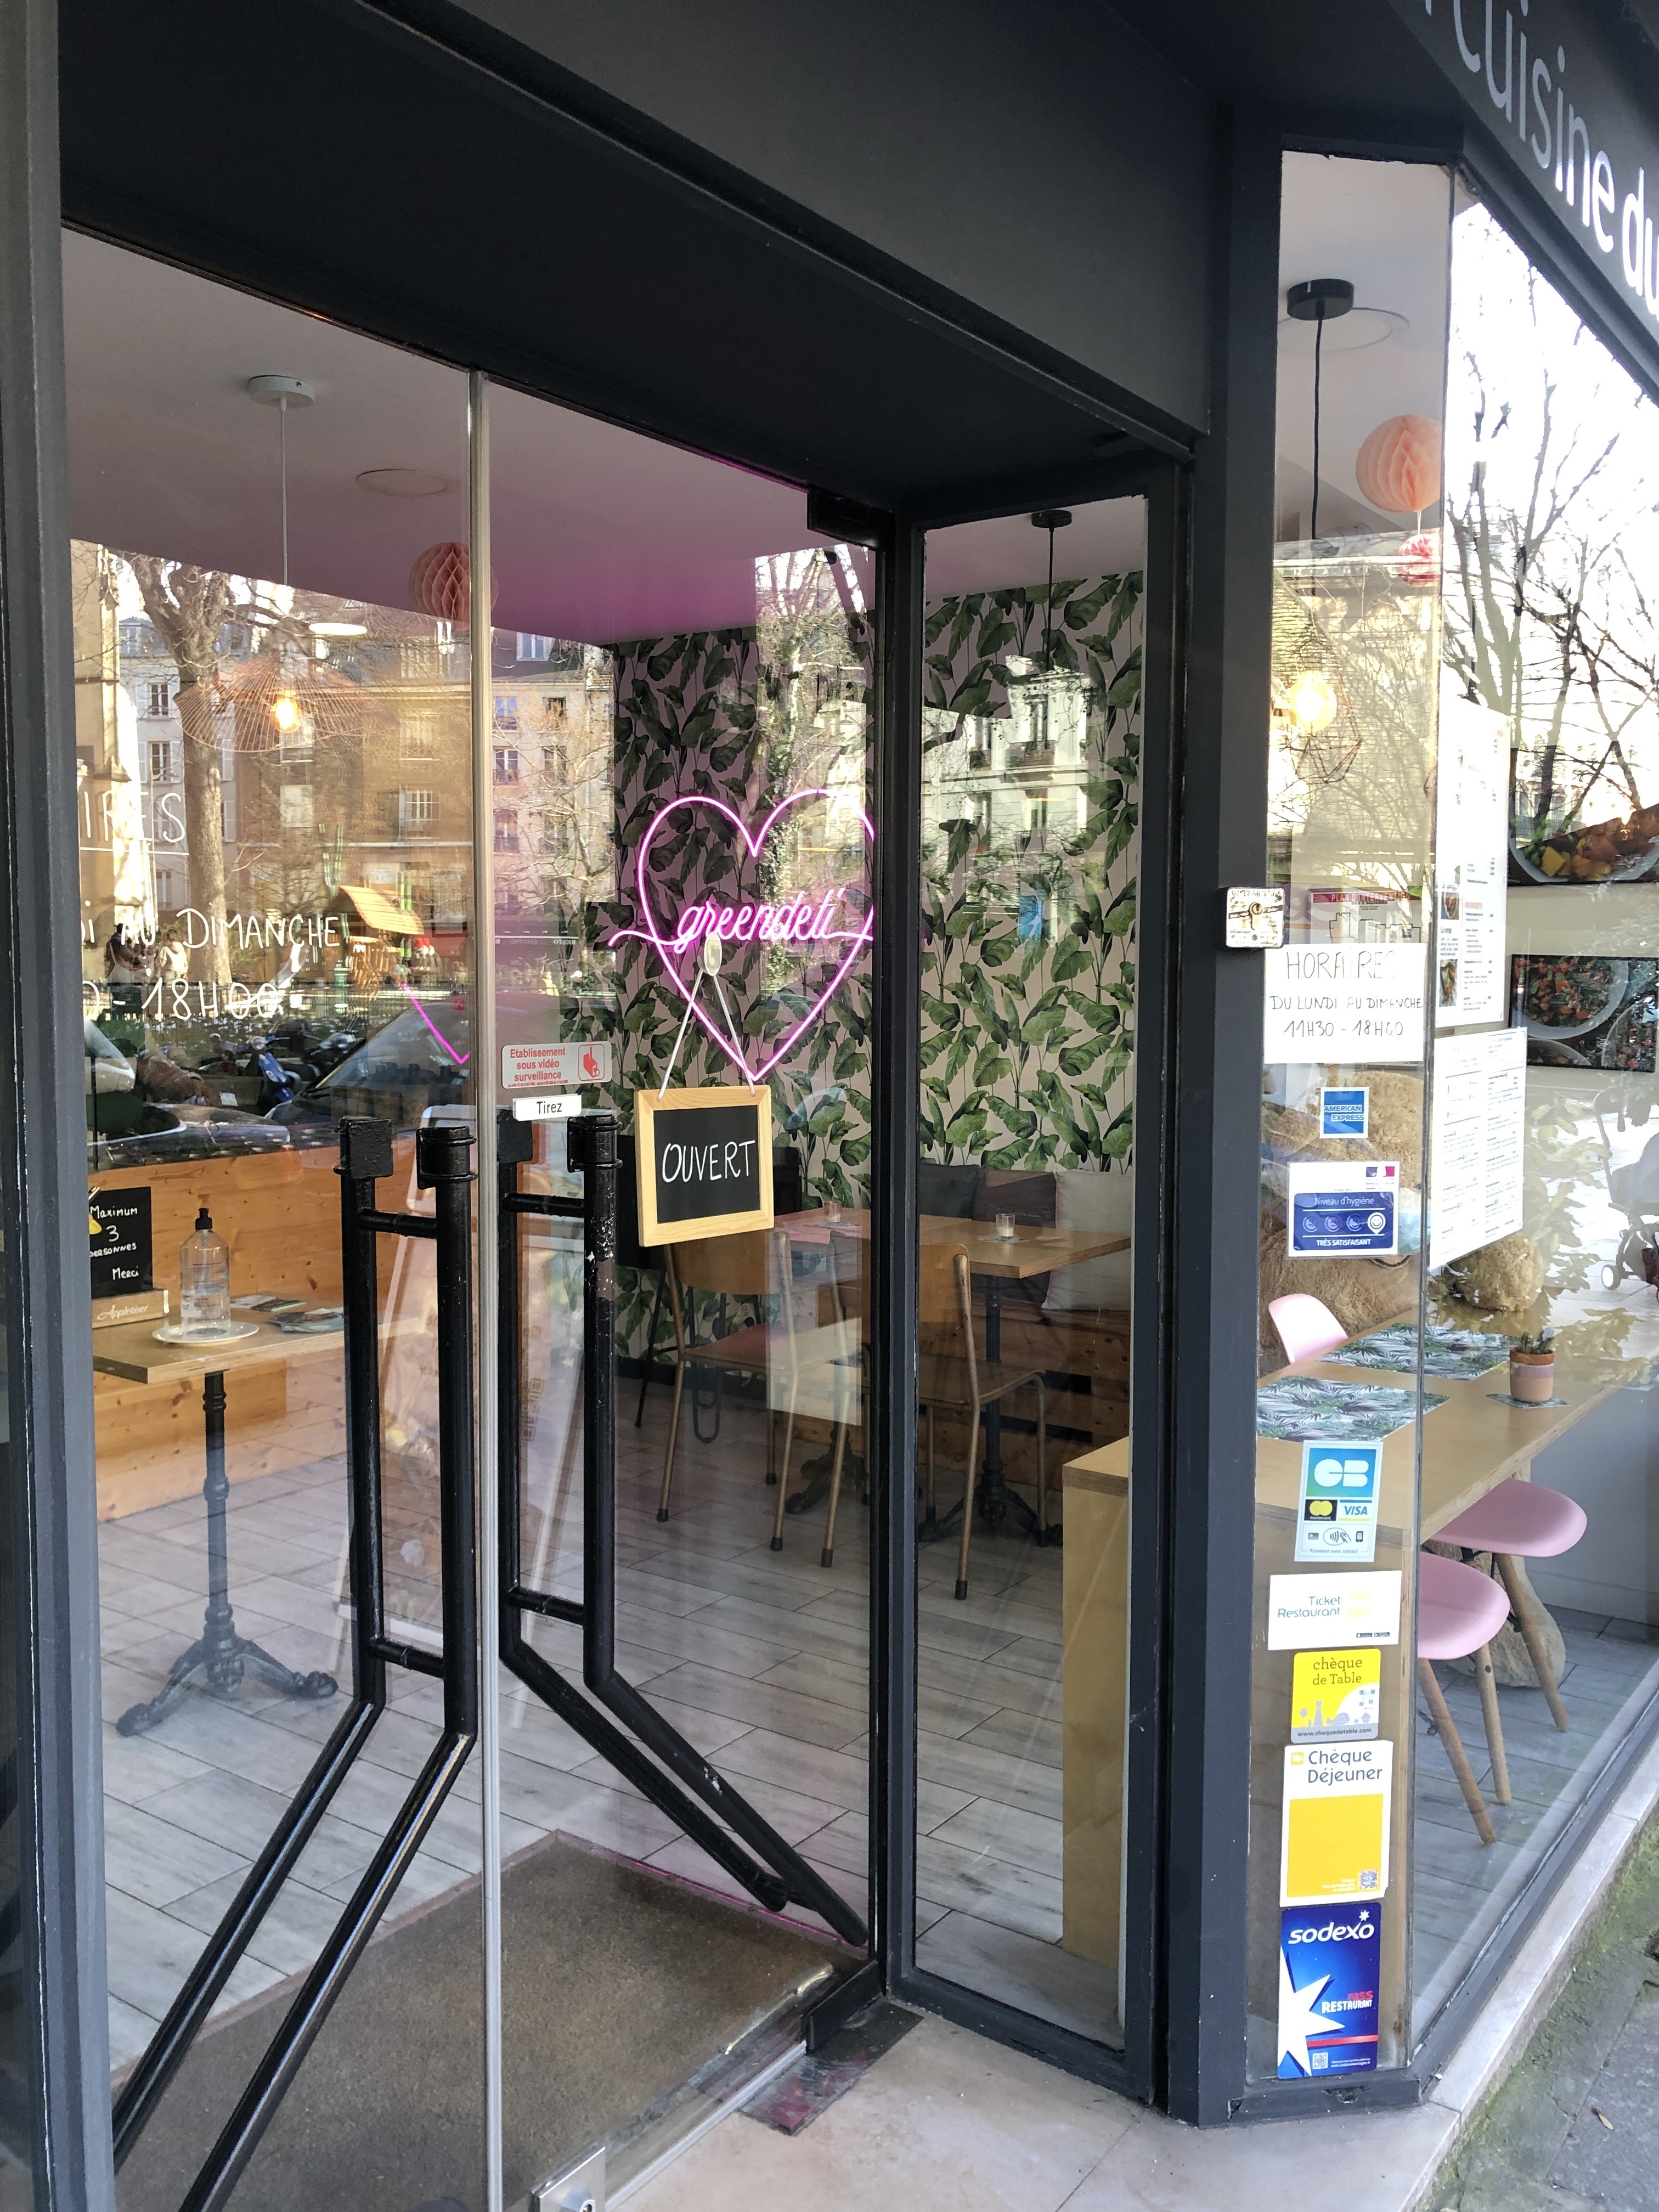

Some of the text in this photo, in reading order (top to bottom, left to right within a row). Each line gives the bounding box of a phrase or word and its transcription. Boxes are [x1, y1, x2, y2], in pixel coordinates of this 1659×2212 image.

[1331, 893, 1350, 902] PLAN
[1269, 995, 1291, 1010] DU
[1297, 995, 1338, 1010] LUNDI
[1347, 996, 1362, 1009] AU
[1284, 1019, 1334, 1037] 11H30
[1352, 1019, 1404, 1037] 18H00
[510, 1047, 566, 1059] Etablissement
[516, 1059, 560, 1070] sous vidéo
[514, 1070, 562, 1082] surveillance
[535, 1101, 562, 1115] Tirez
[662, 1139, 756, 1183] OUVERT
[1314, 1197, 1339, 1206] Niveau
[106, 1224, 120, 1243] 3
[1316, 1238, 1372, 1246] TRÈS SATISFAISANT
[1342, 1505, 1368, 1516] VISA
[1308, 1596, 1341, 1606] Ticket
[1278, 1607, 1340, 1618] Restaurant
[1313, 1656, 1363, 1672] chèque
[1312, 1672, 1362, 1685] de Table
[1297, 1728, 1372, 1737] www.chequedetable.com
[1308, 1748, 1373, 1765] Chèque
[1308, 1767, 1383, 1786] Déjeuner
[1288, 1921, 1375, 1944] sodexo
[1321, 1999, 1373, 2014] RESTAURANT
